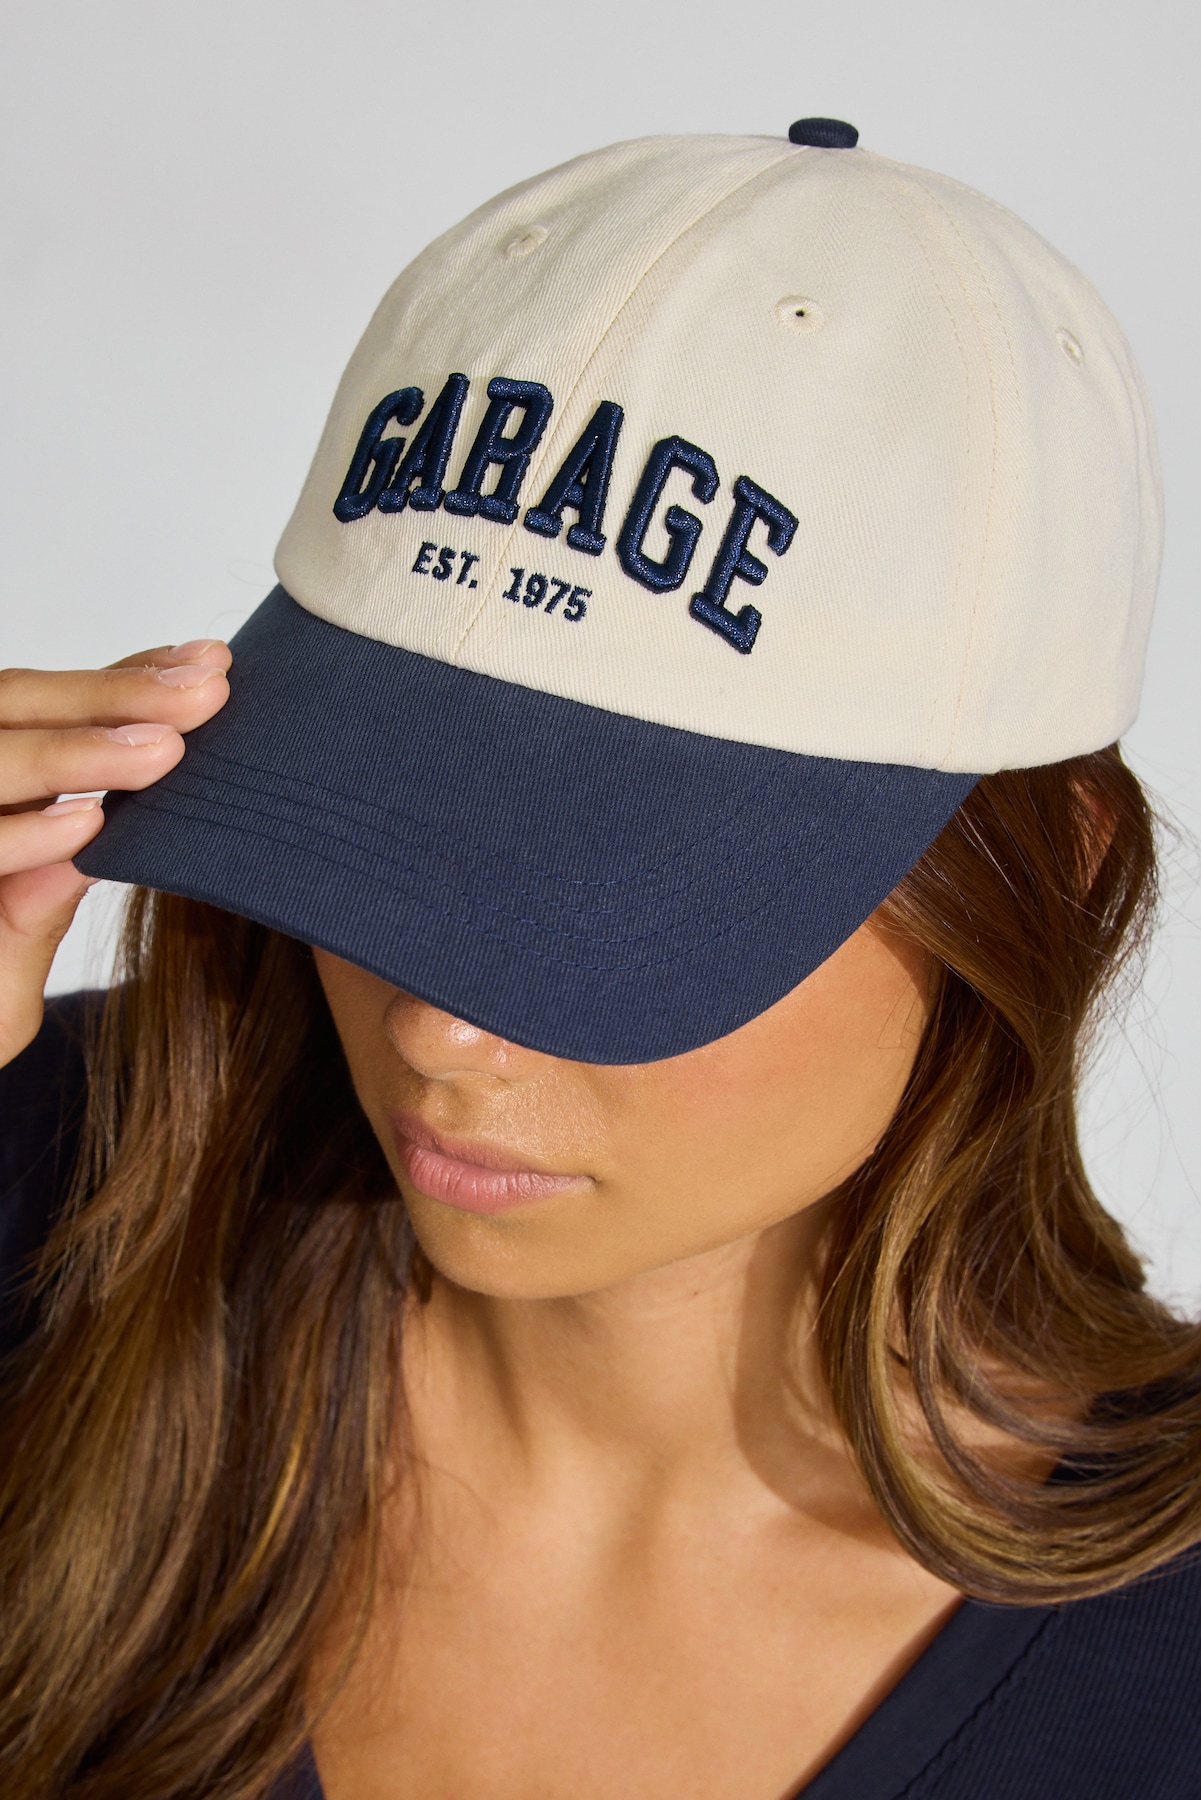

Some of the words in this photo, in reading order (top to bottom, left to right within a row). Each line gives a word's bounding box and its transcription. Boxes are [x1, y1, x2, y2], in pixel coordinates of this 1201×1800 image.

[332, 372, 799, 656] GARAGE
[411, 541, 479, 589] EST.
[501, 567, 593, 623] 1975
